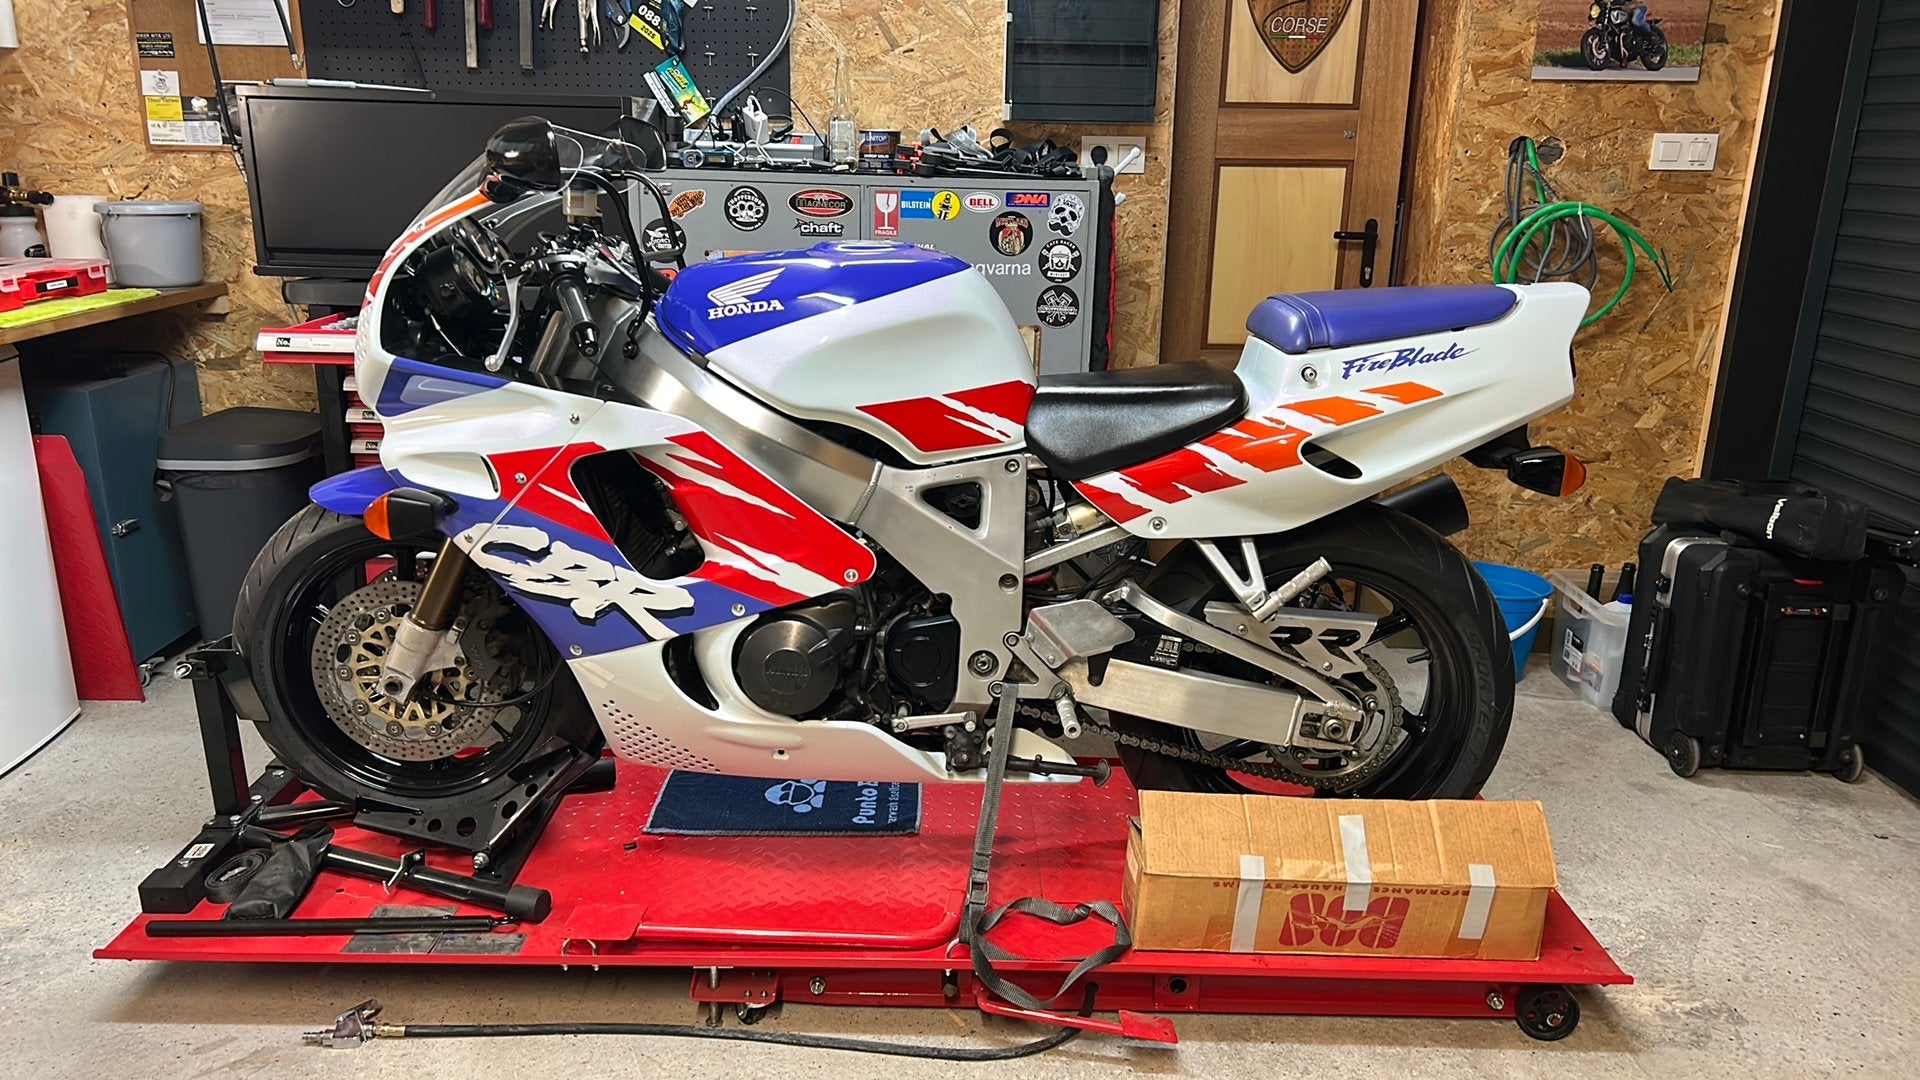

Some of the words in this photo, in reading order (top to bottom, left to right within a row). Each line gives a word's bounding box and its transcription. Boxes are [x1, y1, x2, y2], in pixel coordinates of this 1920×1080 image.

[640, 24, 656, 39] 2025
[1271, 17, 1328, 34] CORSE
[797, 197, 846, 209] MAGNECOR
[901, 201, 931, 209] BILSTEIN
[969, 198, 995, 207] BELL
[1013, 194, 1048, 204] DNA
[1063, 199, 1077, 209] VANS
[800, 221, 842, 234] chaft
[1046, 240, 1059, 248] CAFE
[1060, 240, 1076, 249] RACER
[707, 299, 784, 320] HONDA
[1766, 498, 1788, 540] Velbon
[452, 522, 696, 642] CBR
[851, 787, 878, 824] Punto
[1292, 883, 1343, 893] HAUST
[1373, 886, 1471, 897] RFORMANCE
